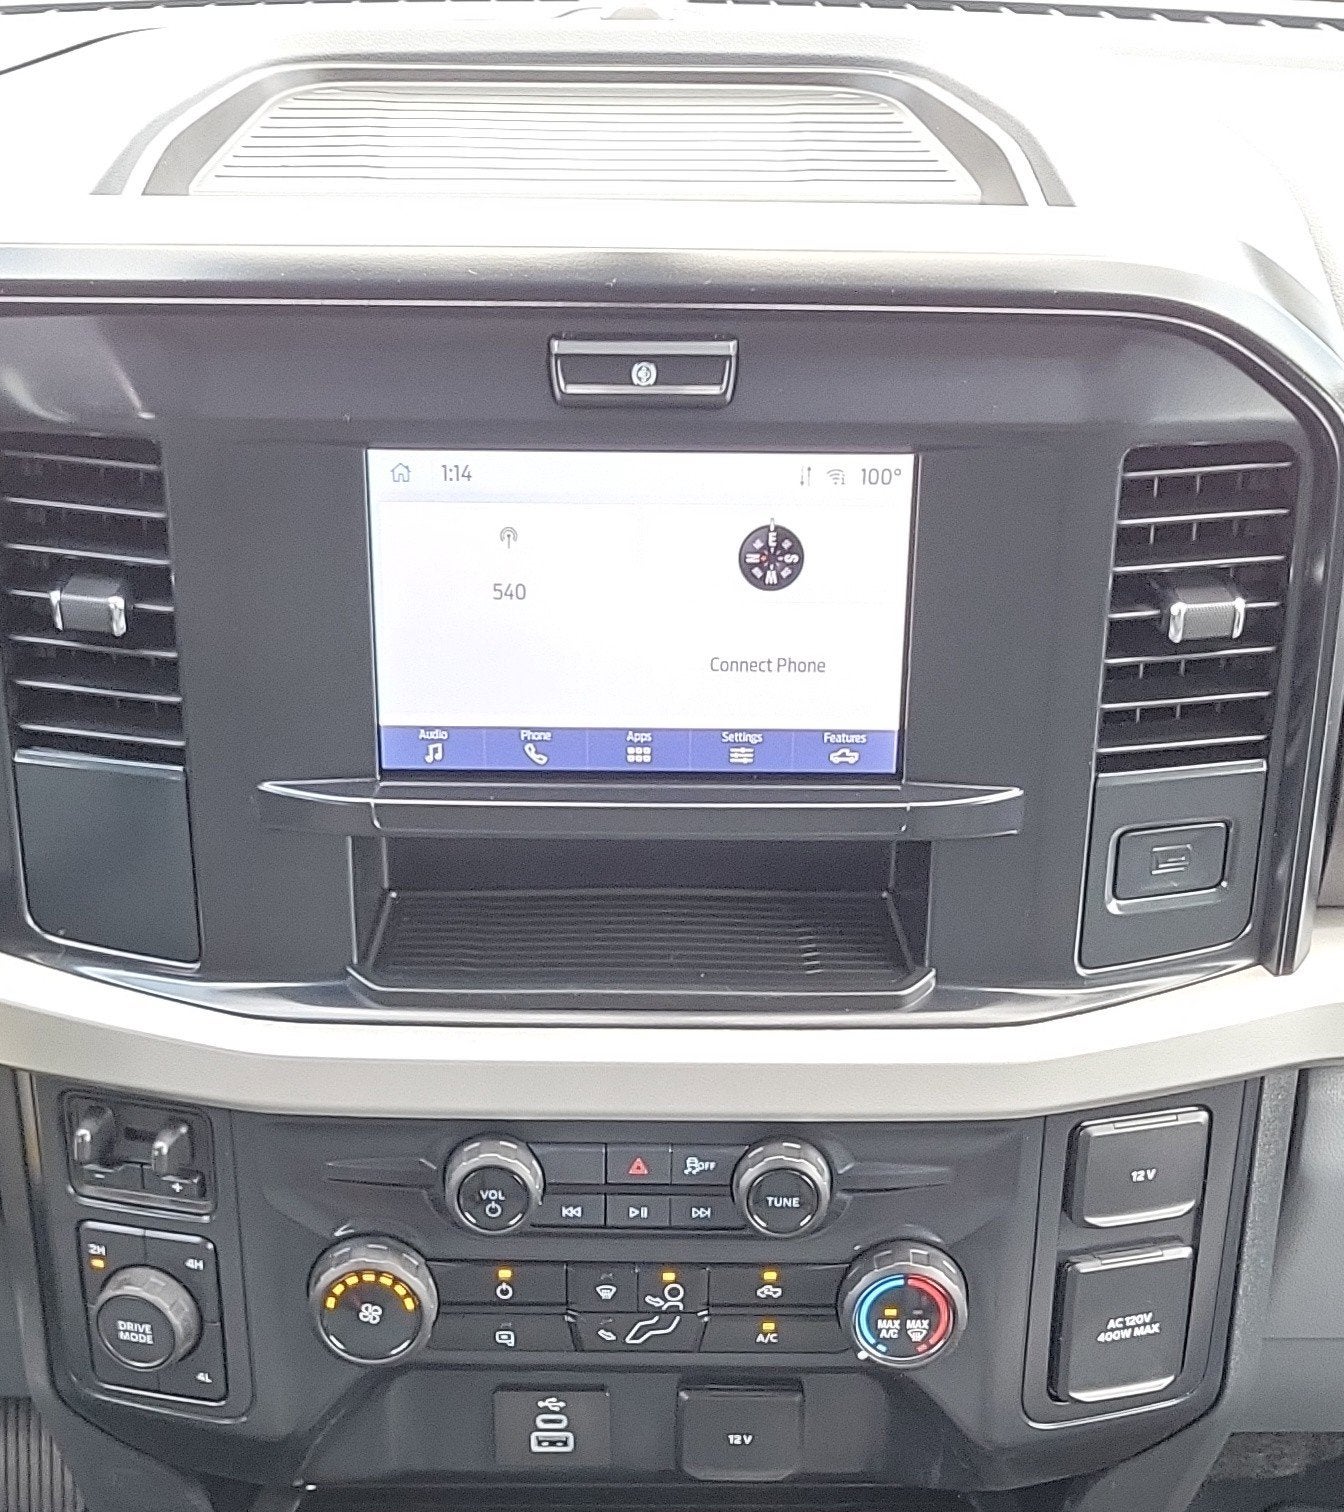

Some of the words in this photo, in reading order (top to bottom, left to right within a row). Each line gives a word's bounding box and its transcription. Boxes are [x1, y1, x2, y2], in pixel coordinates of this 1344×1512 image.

[440, 464, 473, 482] 1:14
[860, 468, 903, 486] 100°
[768, 531, 778, 547] E
[492, 582, 528, 601] 540
[710, 656, 773, 673] Connect
[777, 657, 827, 673] Phone
[419, 729, 449, 741] Audio
[520, 730, 552, 742] Phone
[626, 732, 652, 745] Apps
[721, 732, 764, 746] Settings
[823, 733, 867, 744] Features
[699, 1161, 717, 1172] OFF
[1130, 1170, 1145, 1183] 12
[479, 1189, 506, 1201] VOL
[766, 1195, 801, 1208] TUNE
[87, 1243, 107, 1256] 2H
[184, 1258, 205, 1271] 4H
[117, 1319, 153, 1334] DRIVE
[877, 1319, 901, 1330] MAX
[906, 1318, 930, 1330] MAX
[1107, 1317, 1124, 1330] AC
[1124, 1311, 1154, 1326] 120V
[117, 1331, 155, 1345] MODE
[756, 1333, 779, 1344] A/C
[879, 1329, 899, 1339] A/C
[1096, 1328, 1133, 1343] 400W
[1132, 1322, 1161, 1337] MAX
[195, 1372, 213, 1384] 4L
[727, 1434, 742, 1445] 12
[743, 1434, 754, 1445] V
